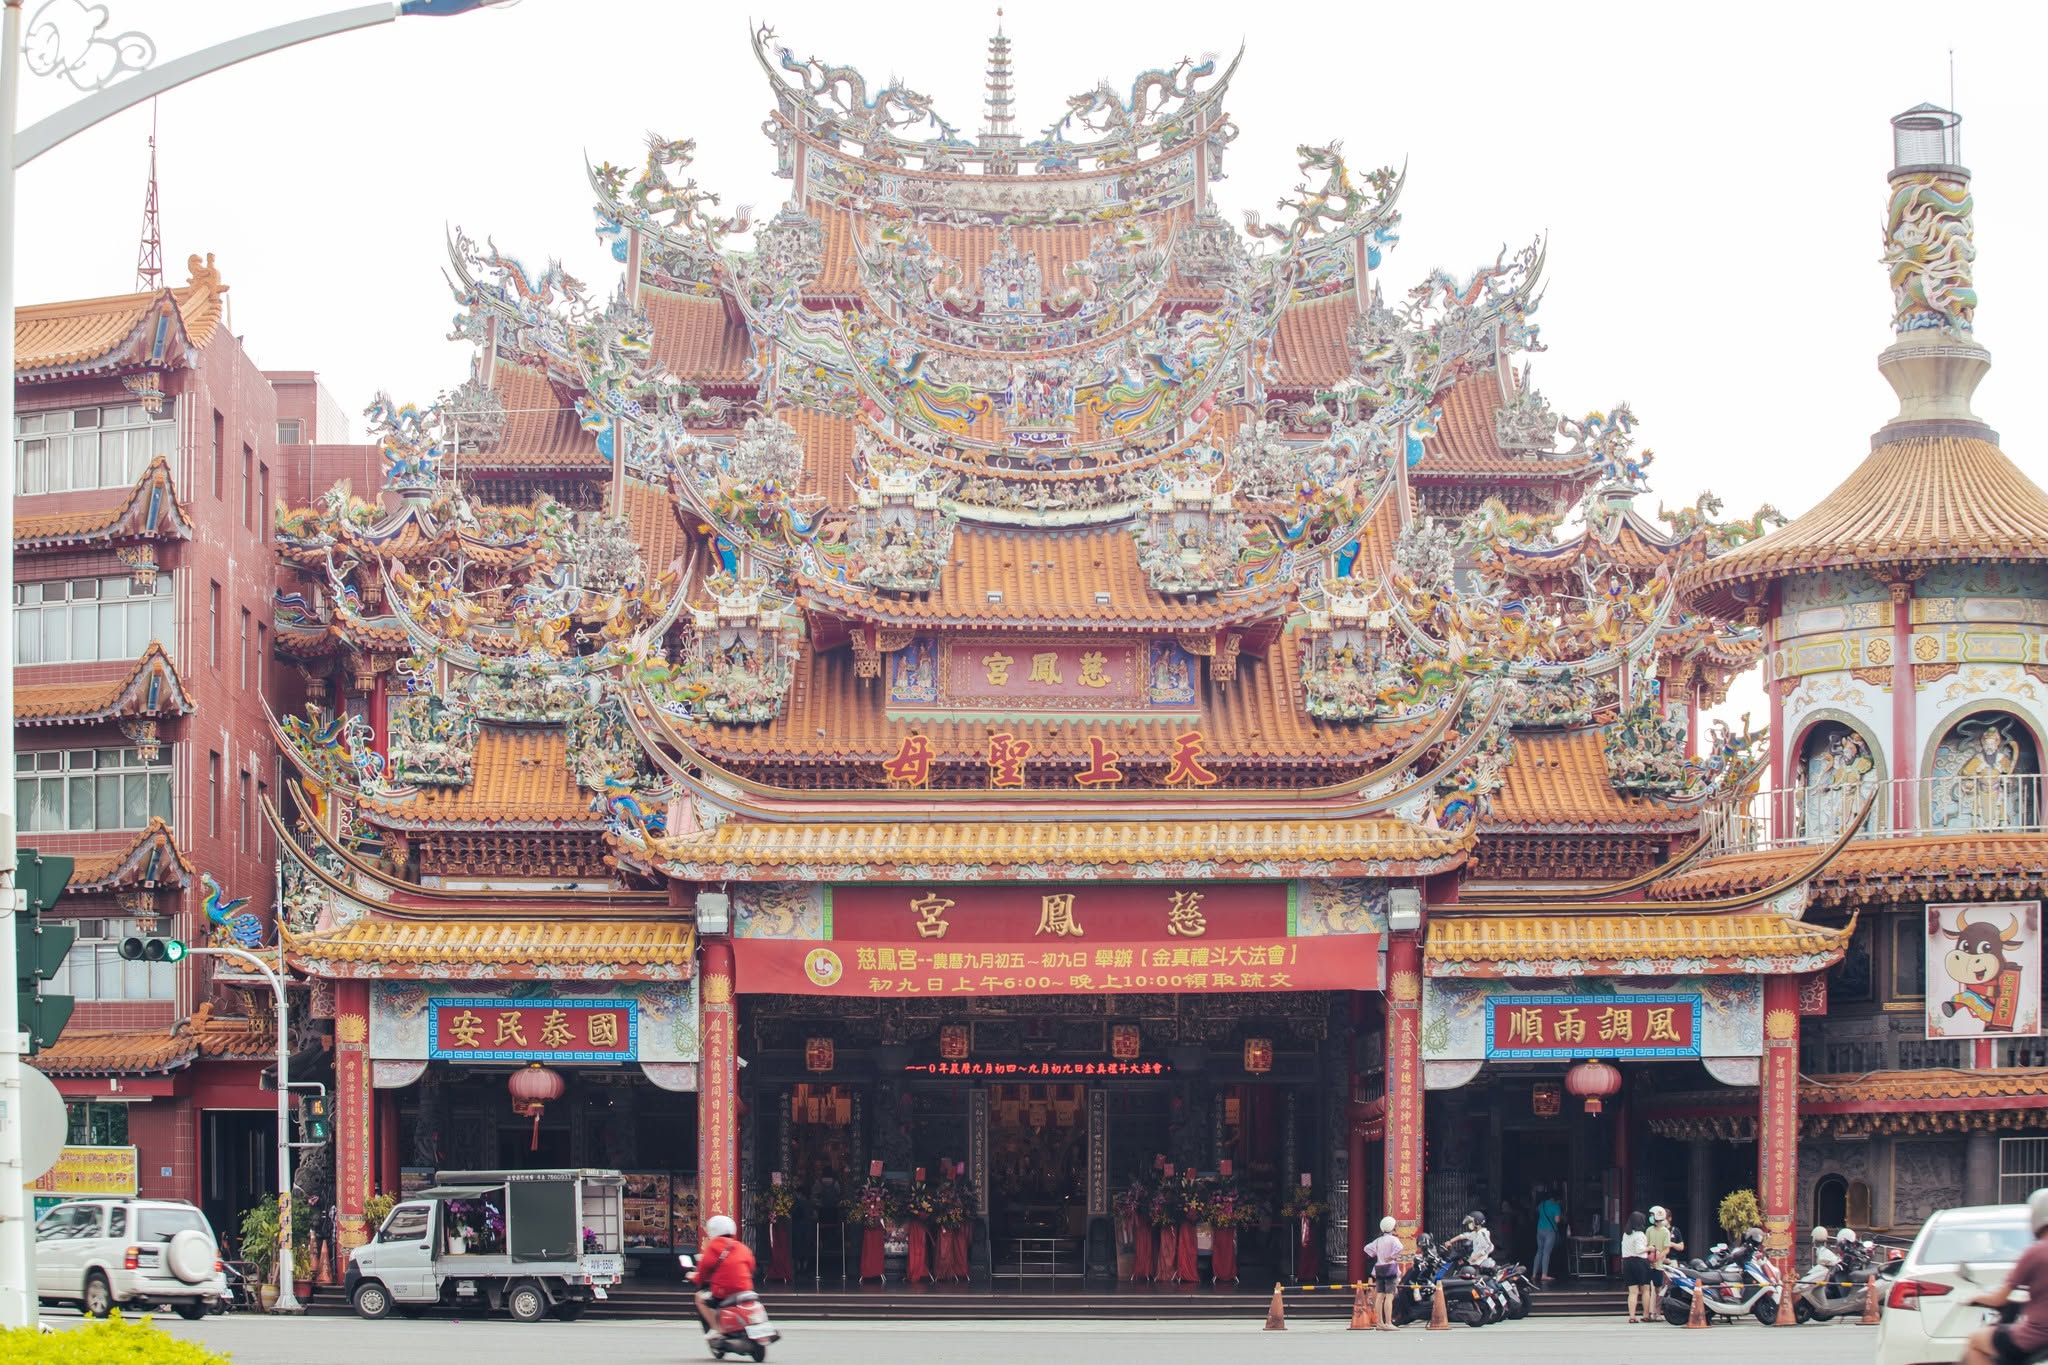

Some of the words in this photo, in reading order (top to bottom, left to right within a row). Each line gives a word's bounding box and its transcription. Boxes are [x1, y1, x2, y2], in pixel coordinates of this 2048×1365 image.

[883, 731, 1217, 786] 天上聖母
[909, 891, 1207, 938] 慈鳳宮
[448, 1009, 619, 1049] 國泰民安
[1507, 1006, 1681, 1044] 風調雨順
